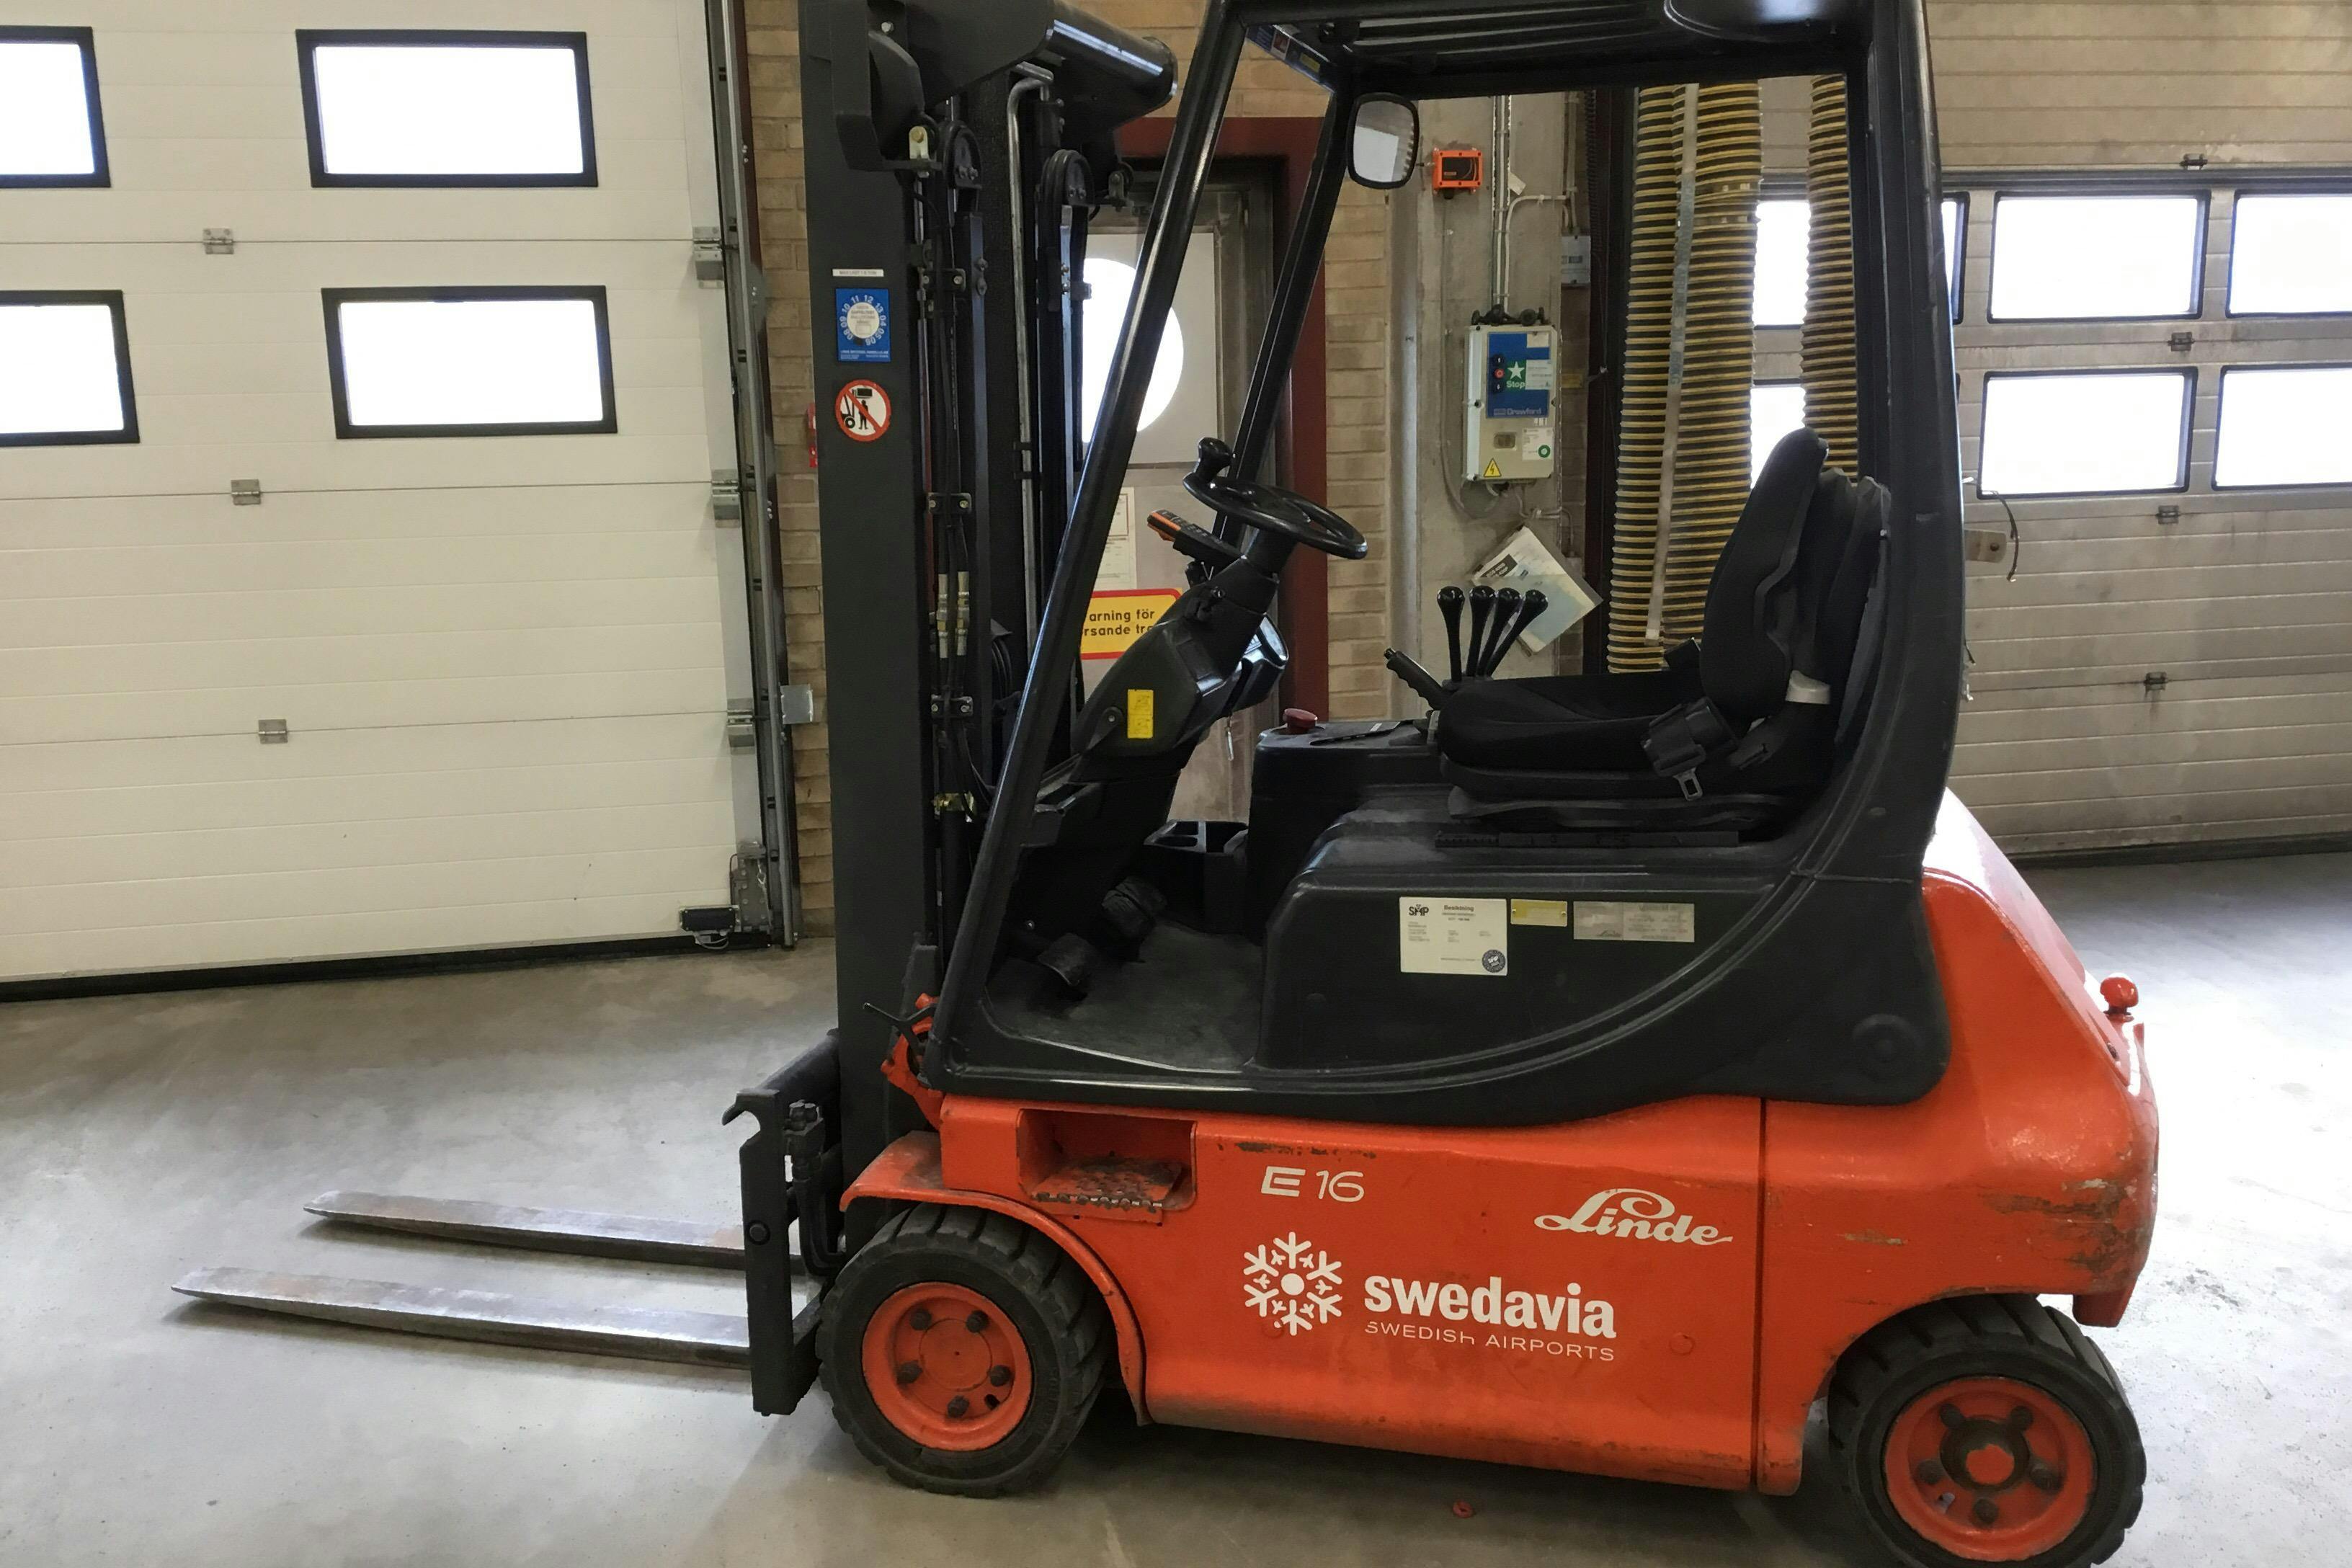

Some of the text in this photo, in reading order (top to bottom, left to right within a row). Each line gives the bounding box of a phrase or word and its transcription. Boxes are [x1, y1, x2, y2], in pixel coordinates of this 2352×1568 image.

[864, 295, 874, 303] 12
[842, 303, 850, 313] 10
[876, 303, 883, 313] 13
[839, 316, 847, 328] 09
[880, 315, 886, 326] 04
[843, 329, 853, 340] 08
[876, 328, 885, 339] 05
[865, 337, 876, 346] 06
[1506, 380, 1525, 389] Stop
[1089, 609, 1155, 623] arning för
[1083, 625, 1131, 636] rsande
[1409, 906, 1429, 917] SMP
[1261, 1167, 1364, 1203] E 16
[1534, 1188, 1732, 1245] Linde
[1364, 1276, 1616, 1338] swedavia
[1485, 1335, 1615, 1360] AIRPORTS
